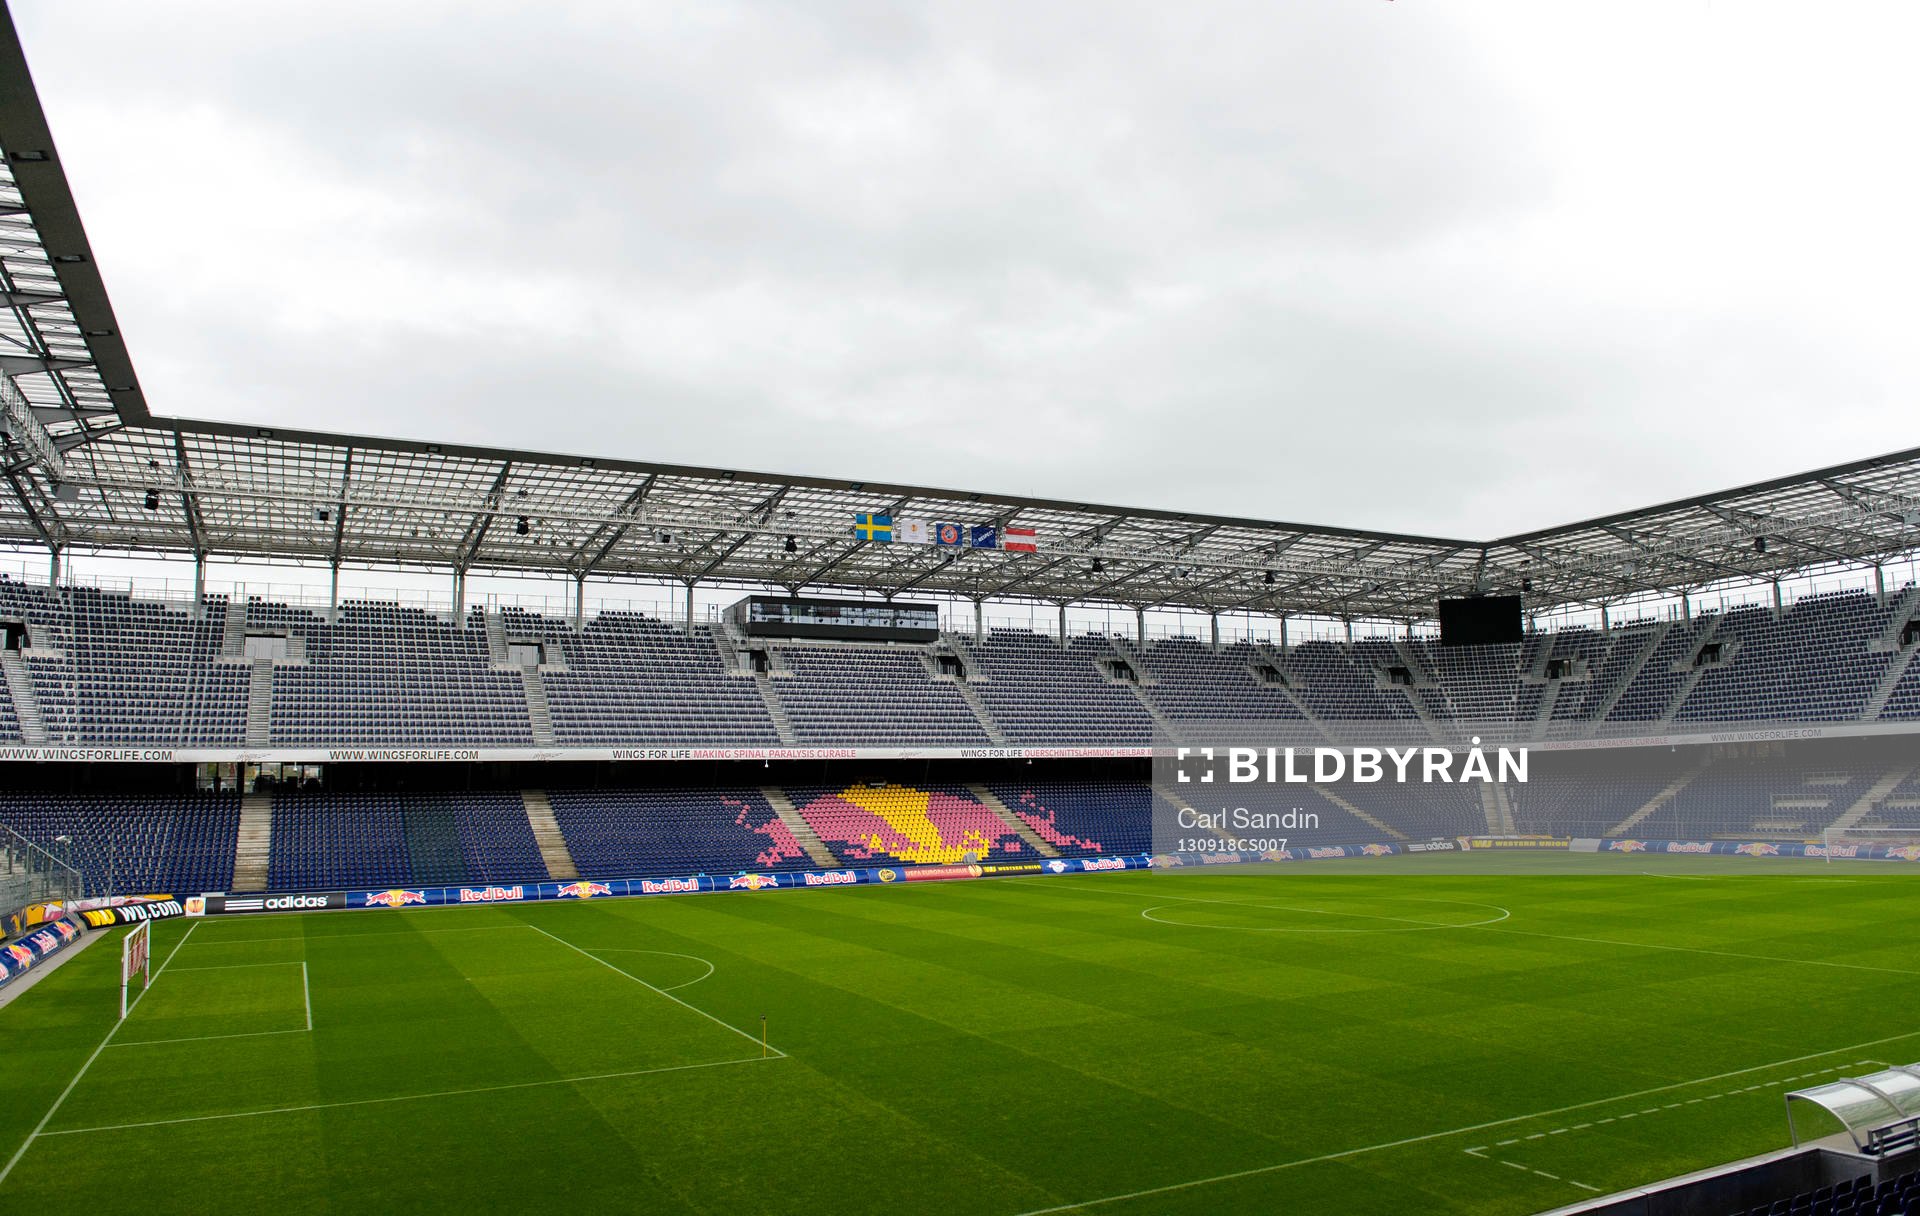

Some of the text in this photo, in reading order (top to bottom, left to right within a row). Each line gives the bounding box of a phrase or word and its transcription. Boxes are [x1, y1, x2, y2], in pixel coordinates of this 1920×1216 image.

[1711, 729, 1822, 741] WWW.WINGSFORLIFE.COM
[329, 750, 479, 760] WWW.WINGSFORLIFE.COM
[613, 749, 857, 759] WINGS FOR LIFE MAKING SPINAL PARALYSIS CURABLE
[961, 749, 987, 758] WINGS
[989, 749, 1005, 758] FOR
[1007, 749, 1022, 758] LIFE
[1117, 749, 1146, 757] HEILBAR
[1426, 841, 1454, 851] adidas
[265, 895, 327, 909] adidas
